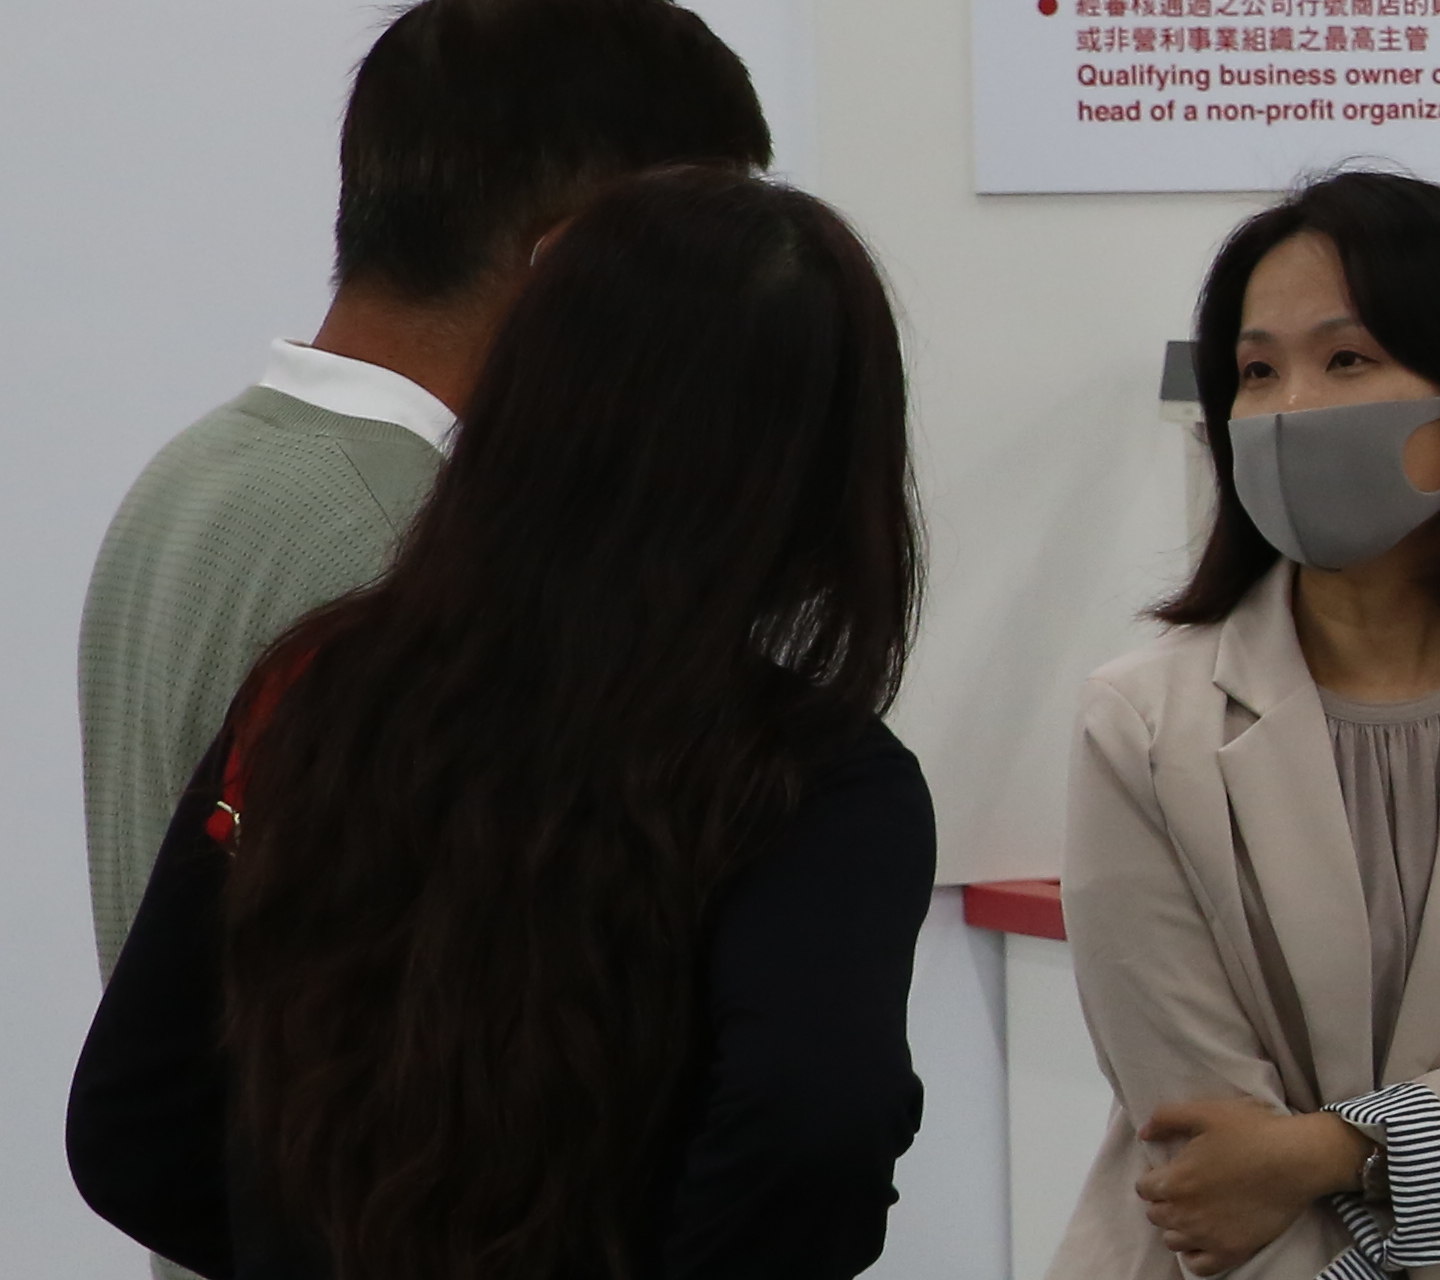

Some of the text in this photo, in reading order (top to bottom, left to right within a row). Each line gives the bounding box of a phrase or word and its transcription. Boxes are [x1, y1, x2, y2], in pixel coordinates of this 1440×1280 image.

[1076, 63, 1211, 92] Qualifying
[1219, 63, 1337, 86] business
[1344, 67, 1424, 86] owner
[1077, 99, 1142, 123] head
[1149, 99, 1176, 122] of
[1183, 104, 1198, 122] a
[1206, 98, 1335, 127] non-profit
